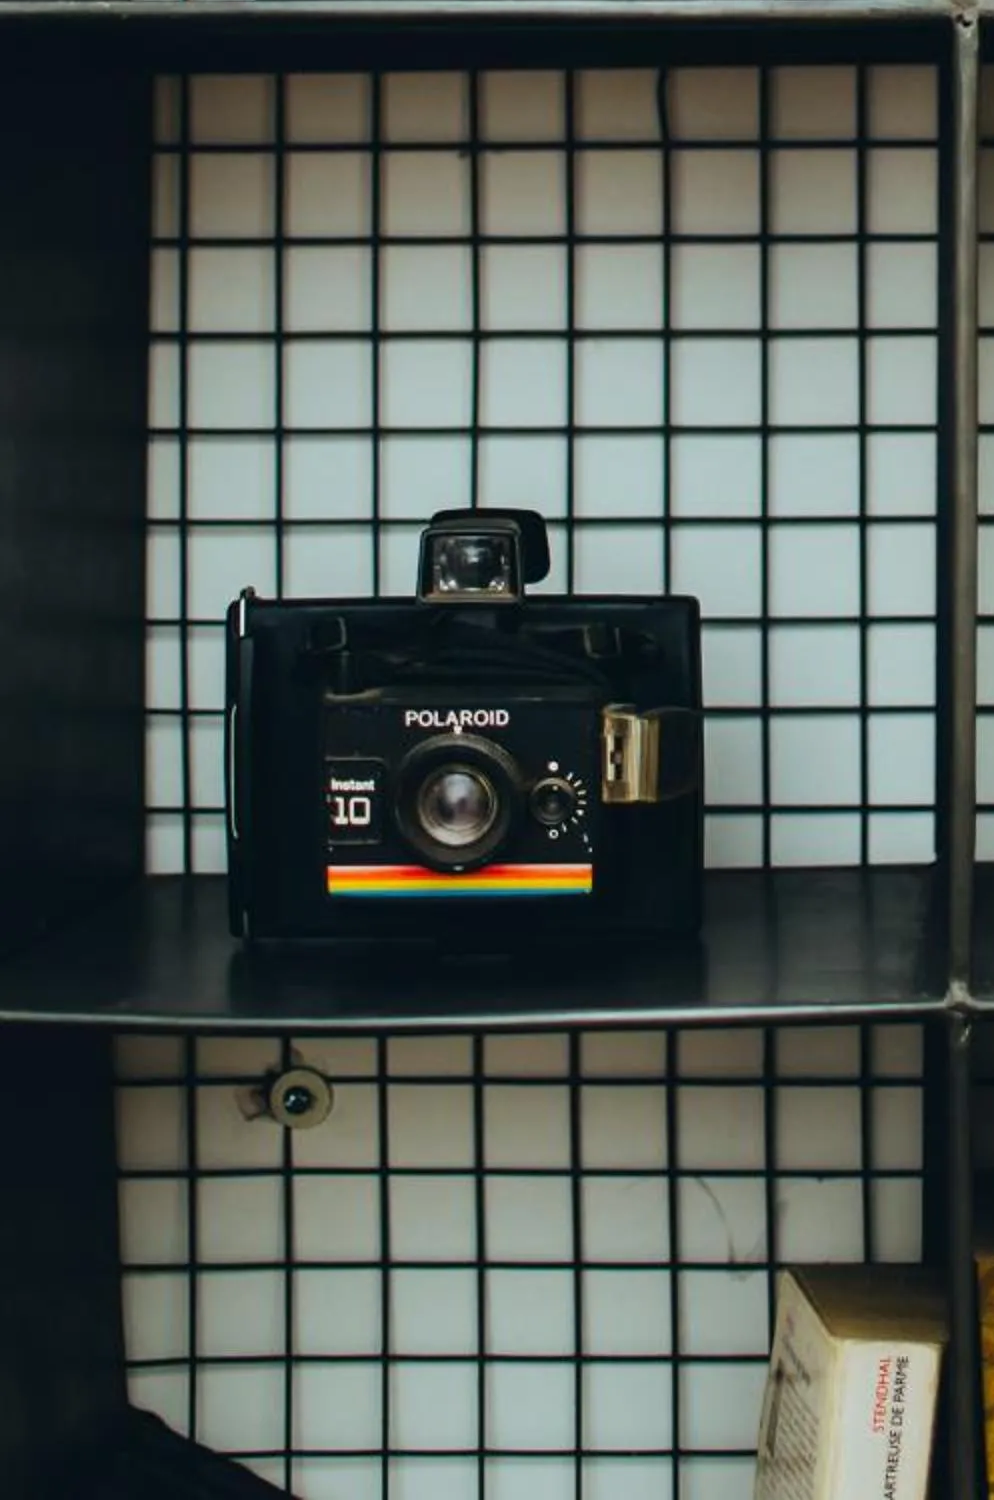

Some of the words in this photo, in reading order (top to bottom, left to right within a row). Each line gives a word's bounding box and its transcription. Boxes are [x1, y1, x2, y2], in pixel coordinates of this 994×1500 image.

[404, 709, 510, 728] POLAROID
[330, 778, 375, 792] Instant
[331, 797, 371, 826] 10
[893, 1355, 909, 1403] PARME
[873, 1356, 891, 1434] STENDHAL
[891, 1406, 905, 1427] DE
[883, 1430, 902, 1500] ARTREUSE
